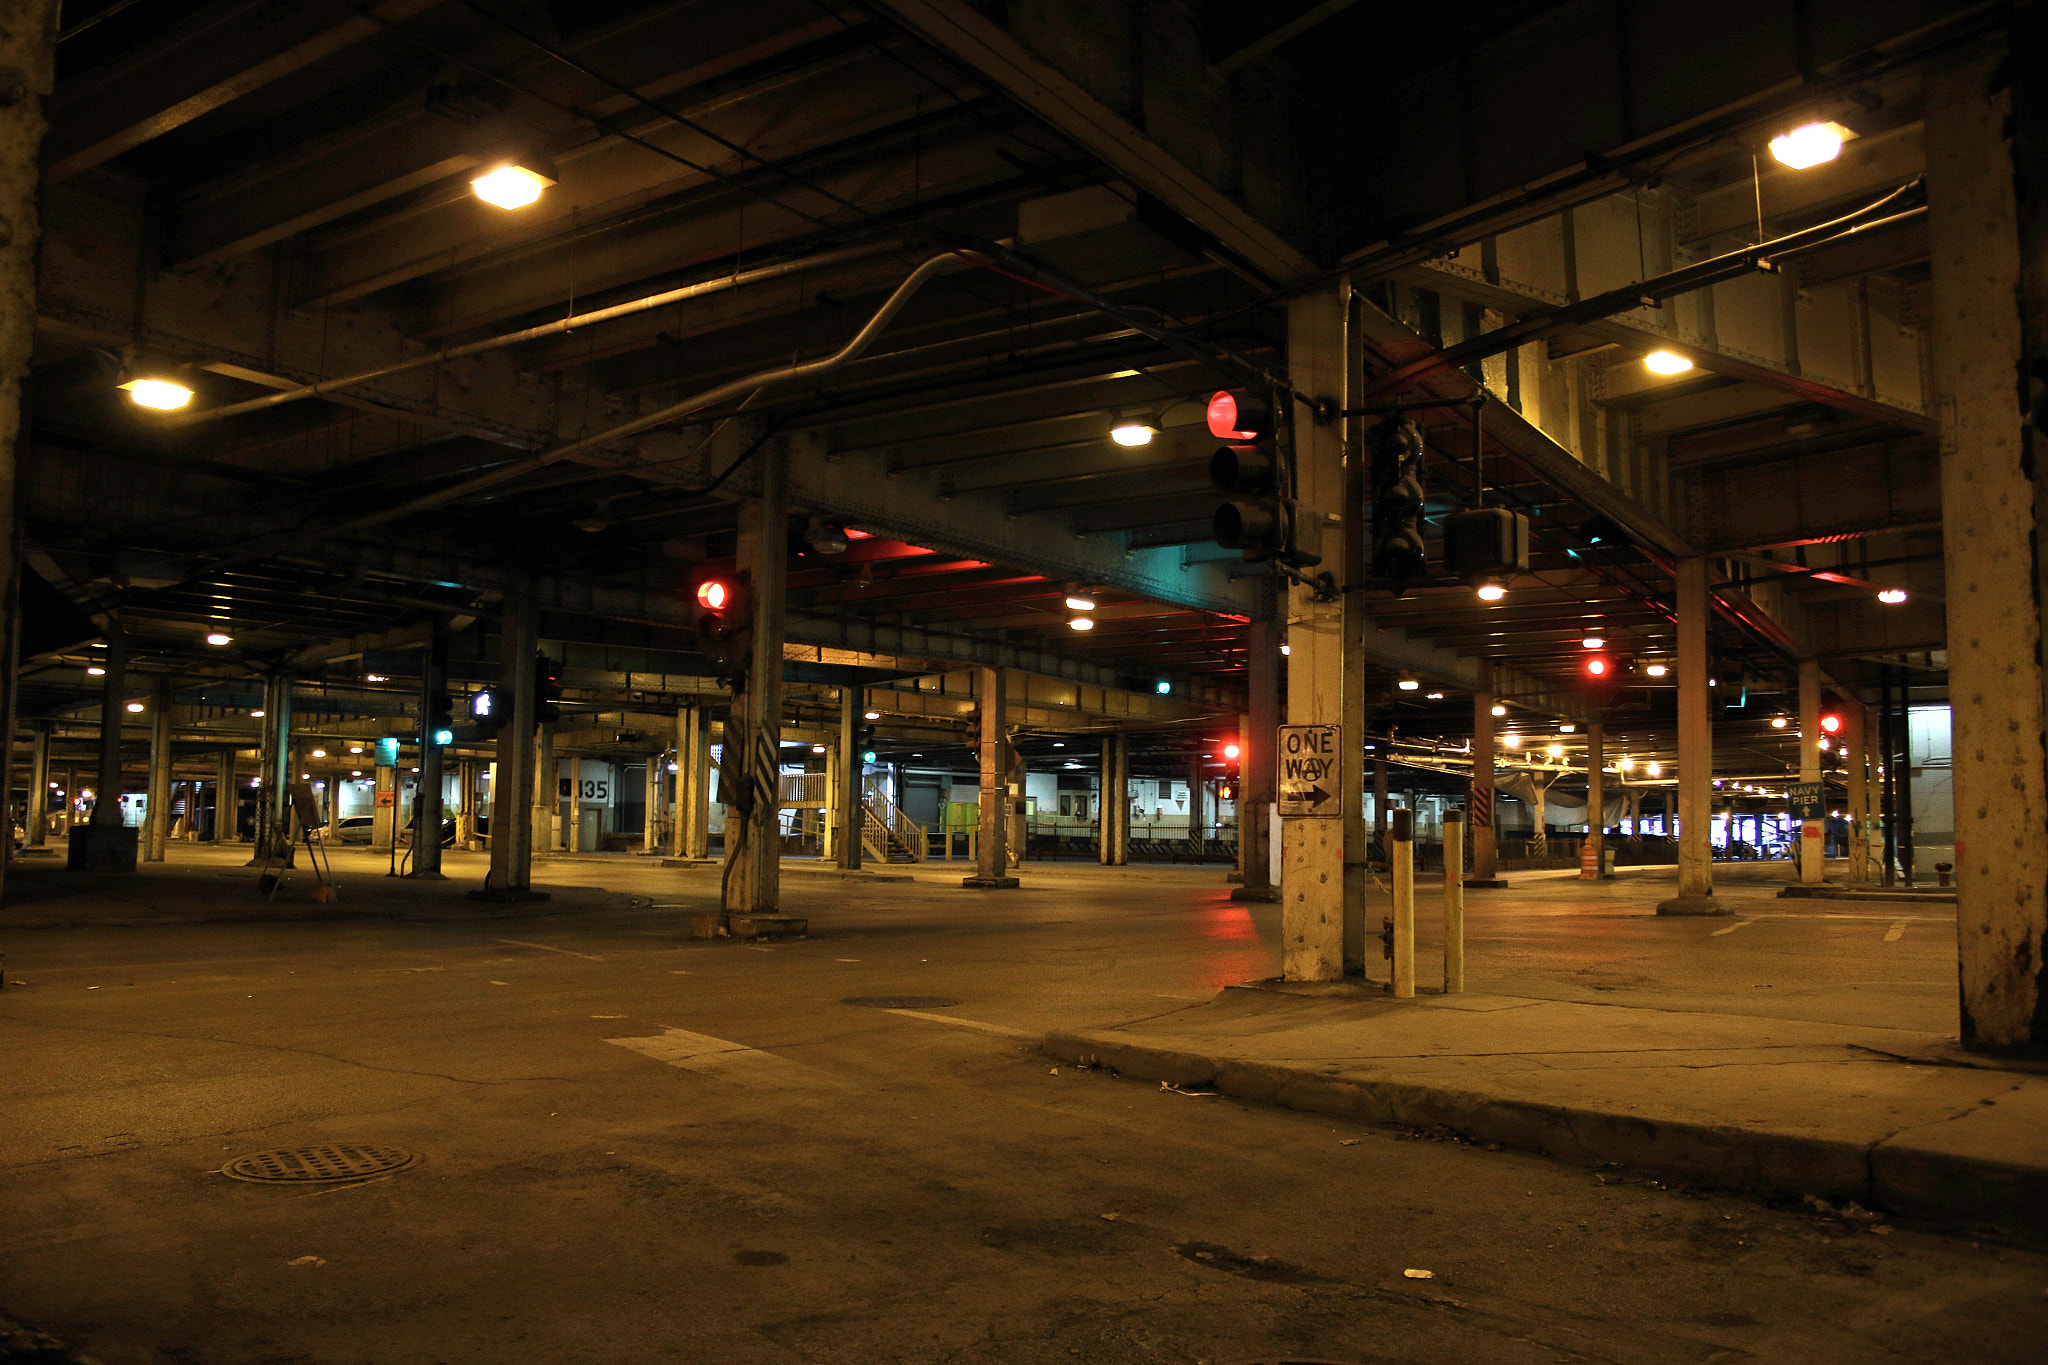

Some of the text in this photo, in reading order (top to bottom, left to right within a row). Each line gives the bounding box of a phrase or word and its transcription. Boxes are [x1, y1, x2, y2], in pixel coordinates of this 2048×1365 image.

[1287, 733, 1333, 754] ONE
[1286, 758, 1334, 780] WAY
[1789, 785, 1820, 796] NAVY
[1793, 795, 1819, 805] PIER
